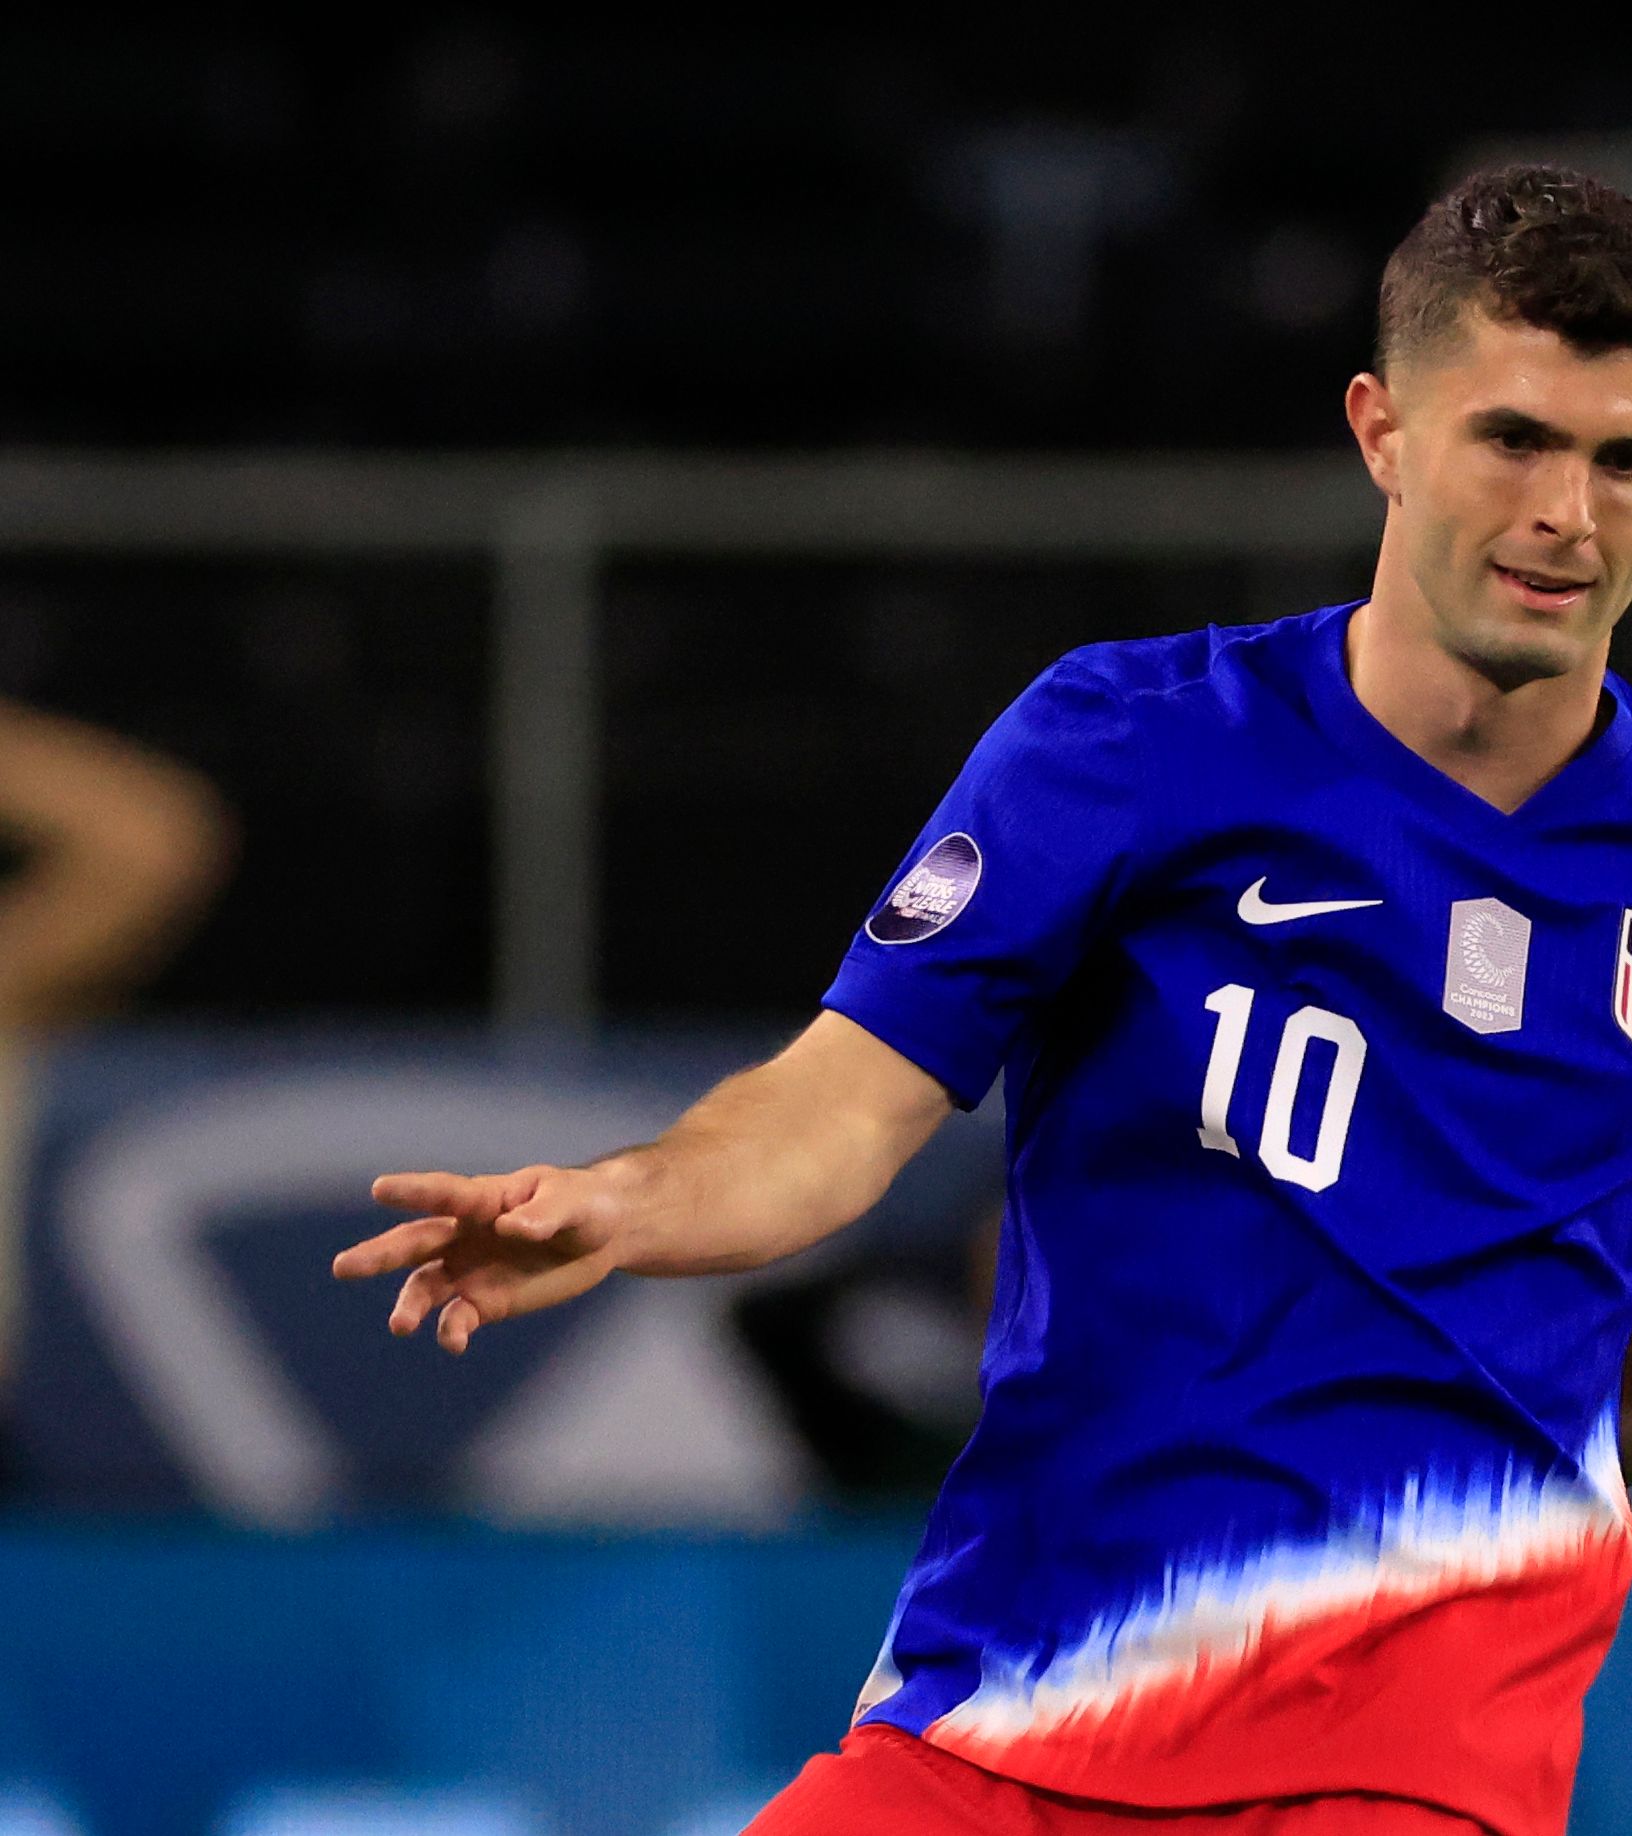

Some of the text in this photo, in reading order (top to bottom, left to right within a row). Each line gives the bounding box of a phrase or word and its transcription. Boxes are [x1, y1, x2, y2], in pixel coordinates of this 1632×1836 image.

[913, 895, 958, 914] LEAGUE
[1450, 992, 1515, 1017] CHAMPIONS
[1198, 984, 1367, 1192] 10
